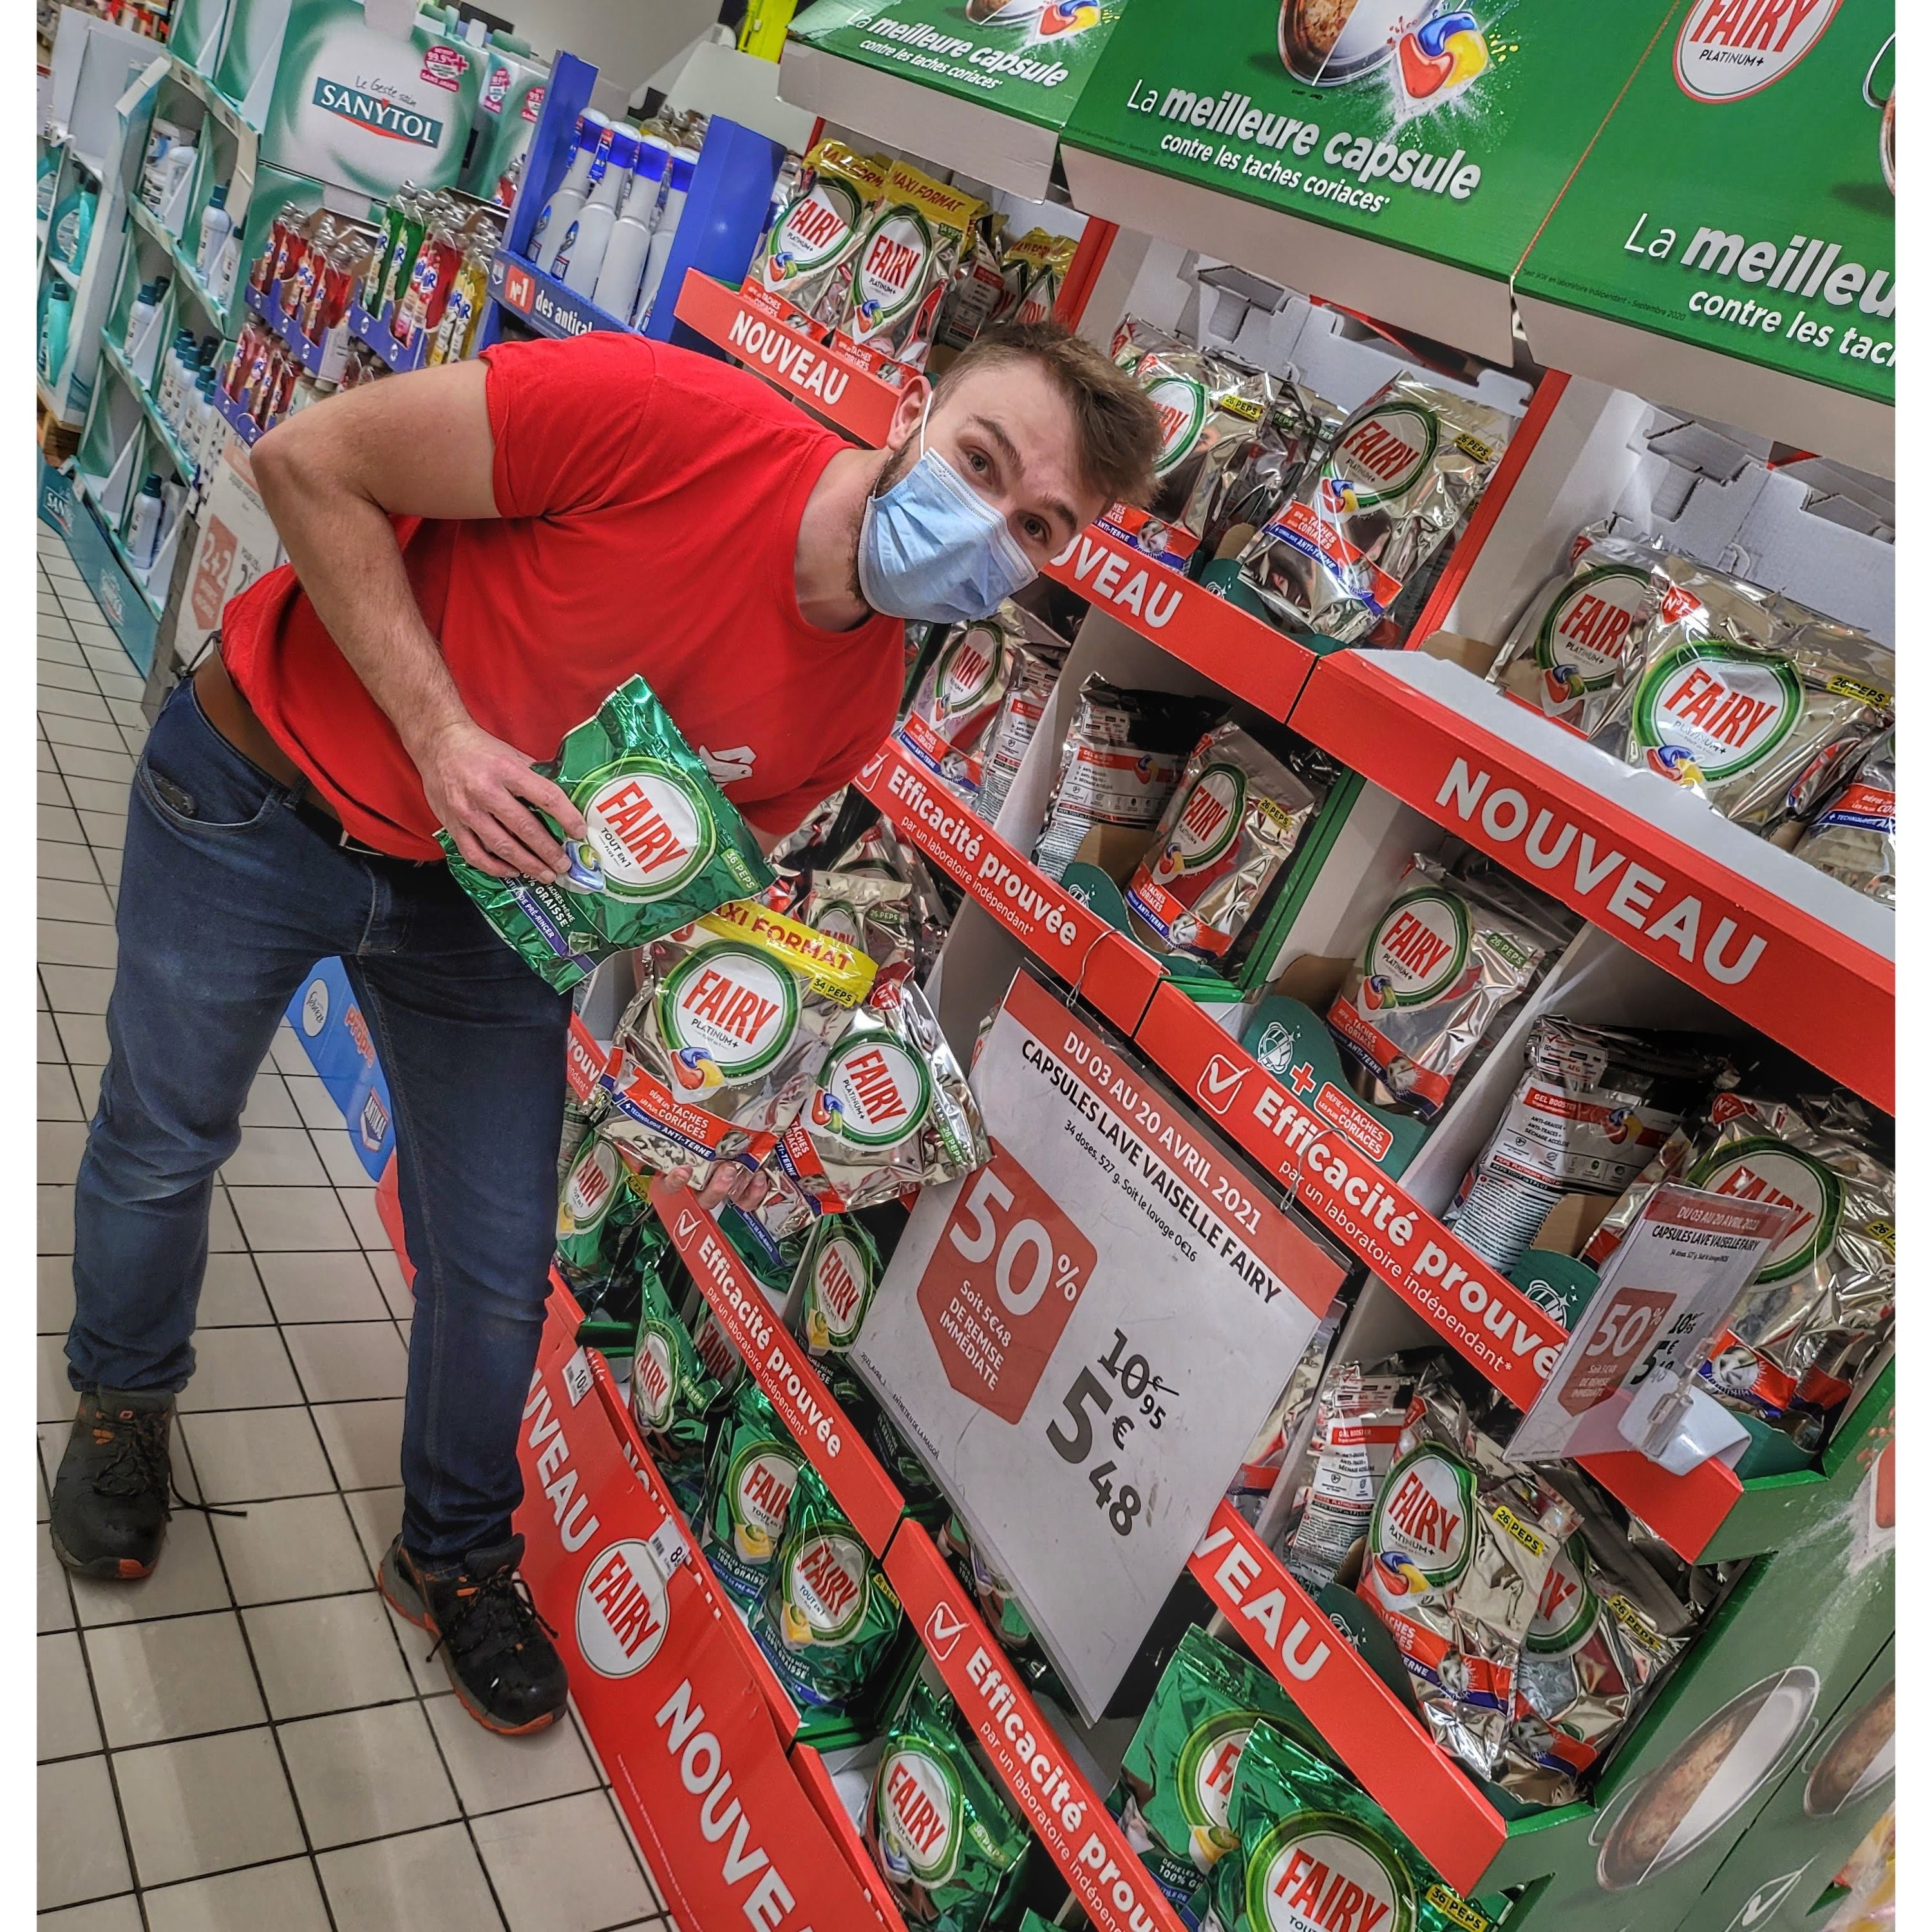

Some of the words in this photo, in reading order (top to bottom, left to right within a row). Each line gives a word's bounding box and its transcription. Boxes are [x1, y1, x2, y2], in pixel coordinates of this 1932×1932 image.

[847, 9, 871, 31] La
[868, 16, 968, 61] meilleure
[966, 44, 1069, 89] capsule
[1689, 0, 1814, 53] FAIRY
[860, 38, 896, 58] contre
[896, 47, 911, 63] les
[912, 50, 949, 76] taches
[1699, 50, 1764, 67] PLATINUM+
[356, 75, 366, 90] Le
[371, 79, 397, 97] Geste
[321, 84, 433, 143] SANYTOL
[1126, 79, 1158, 115] La
[1159, 86, 1320, 158] meilleure
[1323, 131, 1481, 201] capsule
[1160, 132, 1213, 163] contre
[1213, 142, 1241, 171] les
[1242, 155, 1302, 189] taches
[787, 199, 846, 249] FAIRY
[916, 185, 965, 213] FORMAT
[866, 235, 922, 289] FAIRY
[869, 278, 896, 295] PLATINUM+
[1623, 213, 1676, 259] La
[1680, 225, 1895, 319] meilleu
[536, 290, 553, 317] des
[1557, 278, 1588, 294] laboratoire
[1588, 287, 1627, 305] indépendant
[1633, 300, 1666, 316] Septembre
[1667, 310, 1686, 321] 2020
[1688, 290, 1782, 333] contre
[1785, 310, 1834, 348] les
[1838, 327, 1895, 368] tac
[728, 310, 848, 404] NOUVEAU
[1236, 400, 1258, 416] PEPS
[1343, 421, 1419, 482] FAIRY
[1467, 439, 1490, 459] PEPS
[1097, 521, 1130, 543] ANTI-TERNE
[1566, 641, 1604, 665] PLATINUM+
[1663, 667, 1778, 748] FAIRY
[596, 781, 688, 873] FAIRY
[601, 828, 621, 852] TOUT
[1182, 785, 1228, 842] FAIRY
[726, 852, 737, 864] 36
[735, 866, 755, 888] PEPS
[887, 764, 985, 862] Efficacité
[979, 851, 1077, 946] prouvée
[901, 815, 917, 834] par
[926, 834, 973, 886] laboratoire
[1435, 757, 1767, 984] NOUVEAU
[880, 911, 898, 921] PEPS
[1137, 902, 1166, 932] ANTI-TERNE
[1148, 882, 1166, 902] TACHES
[525, 903, 554, 938] PRÉ-RINCER
[751, 915, 851, 972] FORMAT
[1381, 911, 1452, 979] FAIRY
[1383, 953, 1414, 981] PLATINUM+
[1490, 934, 1501, 949] 26
[1500, 943, 1526, 967] PEPS
[681, 969, 779, 1045] FAIRY
[813, 978, 826, 989] 34
[827, 985, 853, 1003] PEPS
[691, 1018, 739, 1049] PLATINUM+
[1352, 1018, 1377, 1043] TACHES
[1347, 1041, 1383, 1075] ANTI-TERNE
[844, 1049, 907, 1124] FAIRY
[1534, 1094, 1548, 1103] GEL
[630, 1107, 661, 1130] TECHNOLOGIE
[662, 1126, 712, 1158] ANTI-TERNE
[658, 1109, 707, 1139] CORIACES
[671, 1104, 708, 1128] TACHES
[1063, 1030, 1090, 1065] DU
[1088, 1059, 1110, 1085] 03
[1110, 1079, 1136, 1110] AU
[1135, 1101, 1161, 1133] 20
[1159, 1122, 1210, 1189] AVRIL
[1208, 1177, 1262, 1236] 2021
[1318, 1101, 1328, 1112] LES
[1326, 1107, 1339, 1120] PLUS
[1338, 1115, 1383, 1155] CORIACES
[1325, 1090, 1342, 1108] DÉFIE
[1340, 1104, 1351, 1115] LES
[1350, 1108, 1385, 1141] TACHES
[1021, 1039, 1100, 1122] CAPSULES
[1097, 1111, 1142, 1167] LAVE
[1141, 1154, 1222, 1249] VAISELLE
[1220, 1236, 1283, 1306] FAIRY
[1064, 1120, 1076, 1136] 34
[1075, 1131, 1099, 1162] doses.
[1097, 1153, 1113, 1174] 527
[1120, 1178, 1141, 1201] Soit
[1148, 1200, 1176, 1240] lavage
[1174, 1233, 1198, 1264] 0€16
[1252, 1084, 1421, 1249] Efficacité
[1412, 1240, 1566, 1383] prouvé
[1279, 1159, 1303, 1191] par
[1304, 1182, 1323, 1206] un
[1323, 1197, 1403, 1278] laboratoire
[1652, 1225, 1691, 1242] CAPSULES
[1690, 1231, 1712, 1245] LAVE
[1738, 1238, 1761, 1252] FAIRY
[1677, 1206, 1690, 1218] DU
[1690, 1209, 1701, 1222] 03
[1712, 1215, 1725, 1226] 20
[1873, 1224, 1889, 1234] 26
[819, 1246, 860, 1323] FAIRY
[706, 1287, 720, 1303] par
[719, 1303, 728, 1318] un
[727, 1311, 762, 1373] laboratoire
[949, 1298, 970, 1327] DE
[963, 1317, 1005, 1372] REMISE
[960, 1279, 985, 1312] Soit
[980, 1301, 1012, 1348] 5€48
[697, 1235, 774, 1351] Efficacité
[768, 1341, 843, 1459] prouvée
[939, 1309, 998, 1392] IMMÉDIATE
[893, 1393, 914, 1423] ENTRETIEN
[923, 1434, 940, 1459] MAISON
[522, 1367, 600, 1553] UVEAU
[1387, 1470, 1461, 1556] FAIRY
[1496, 1509, 1512, 1528] 26
[1510, 1521, 1541, 1552] PEPS
[1388, 1524, 1435, 1558] PLATINUM+
[588, 1550, 664, 1660] FAIRY
[797, 1541, 858, 1617] FAIRY
[1627, 1612, 1656, 1647] PEPS
[654, 1678, 814, 1932] NOUVE
[887, 1761, 945, 1855] FAIRY
[965, 1645, 1088, 1833] Efficacité
[1079, 1832, 1154, 1932] prou
[981, 1721, 1001, 1749] par
[999, 1748, 1016, 1774] un
[1012, 1769, 1071, 1862] laboratoire
[1070, 1857, 1127, 1932] indépen
[1159, 1866, 1186, 1886] 100%
[1274, 1848, 1389, 1932] FAIRY
[1431, 1887, 1446, 1904] 36
[1448, 1901, 1482, 1929] PEPS
